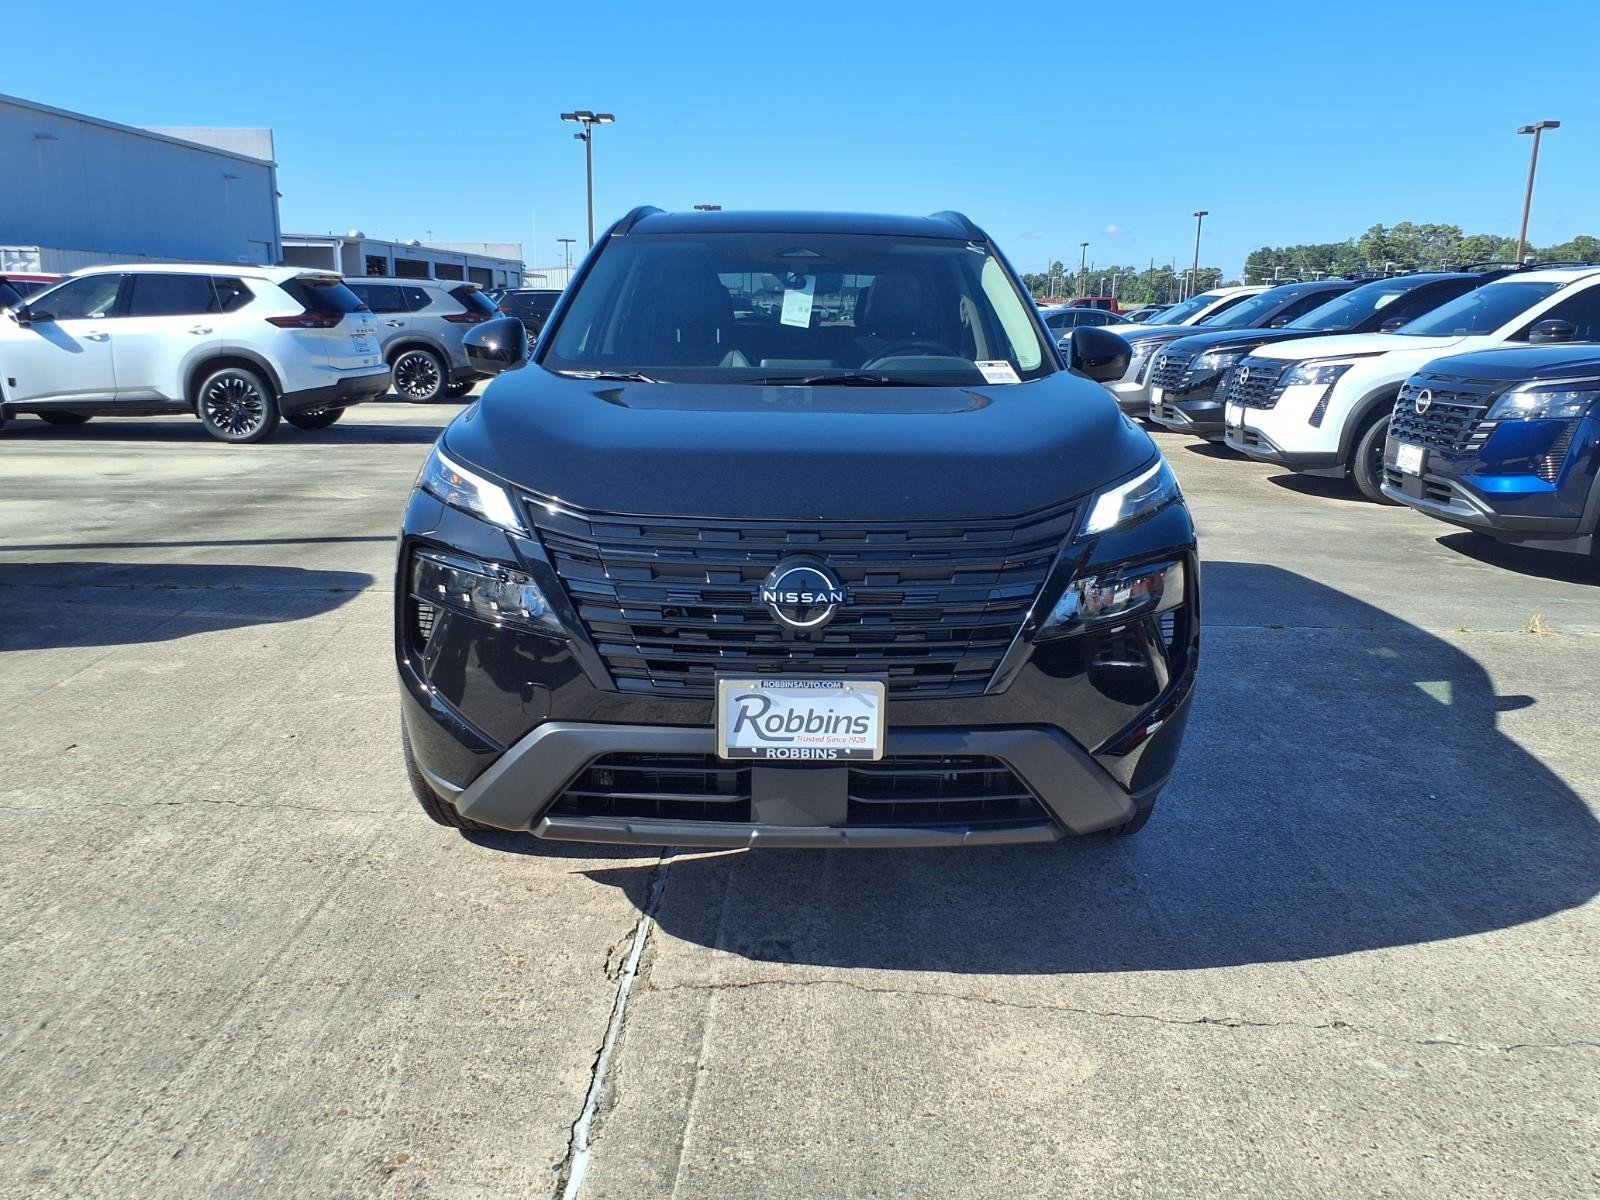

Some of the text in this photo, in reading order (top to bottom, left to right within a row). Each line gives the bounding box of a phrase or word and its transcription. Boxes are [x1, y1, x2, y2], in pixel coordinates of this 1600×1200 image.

[763, 591, 843, 603] NISSAN
[763, 680, 841, 689] ROBBINSAUTO.COM
[733, 694, 870, 741] Robbins
[796, 735, 866, 744] Trusted Since 1928
[766, 749, 837, 759] ROBBINS
